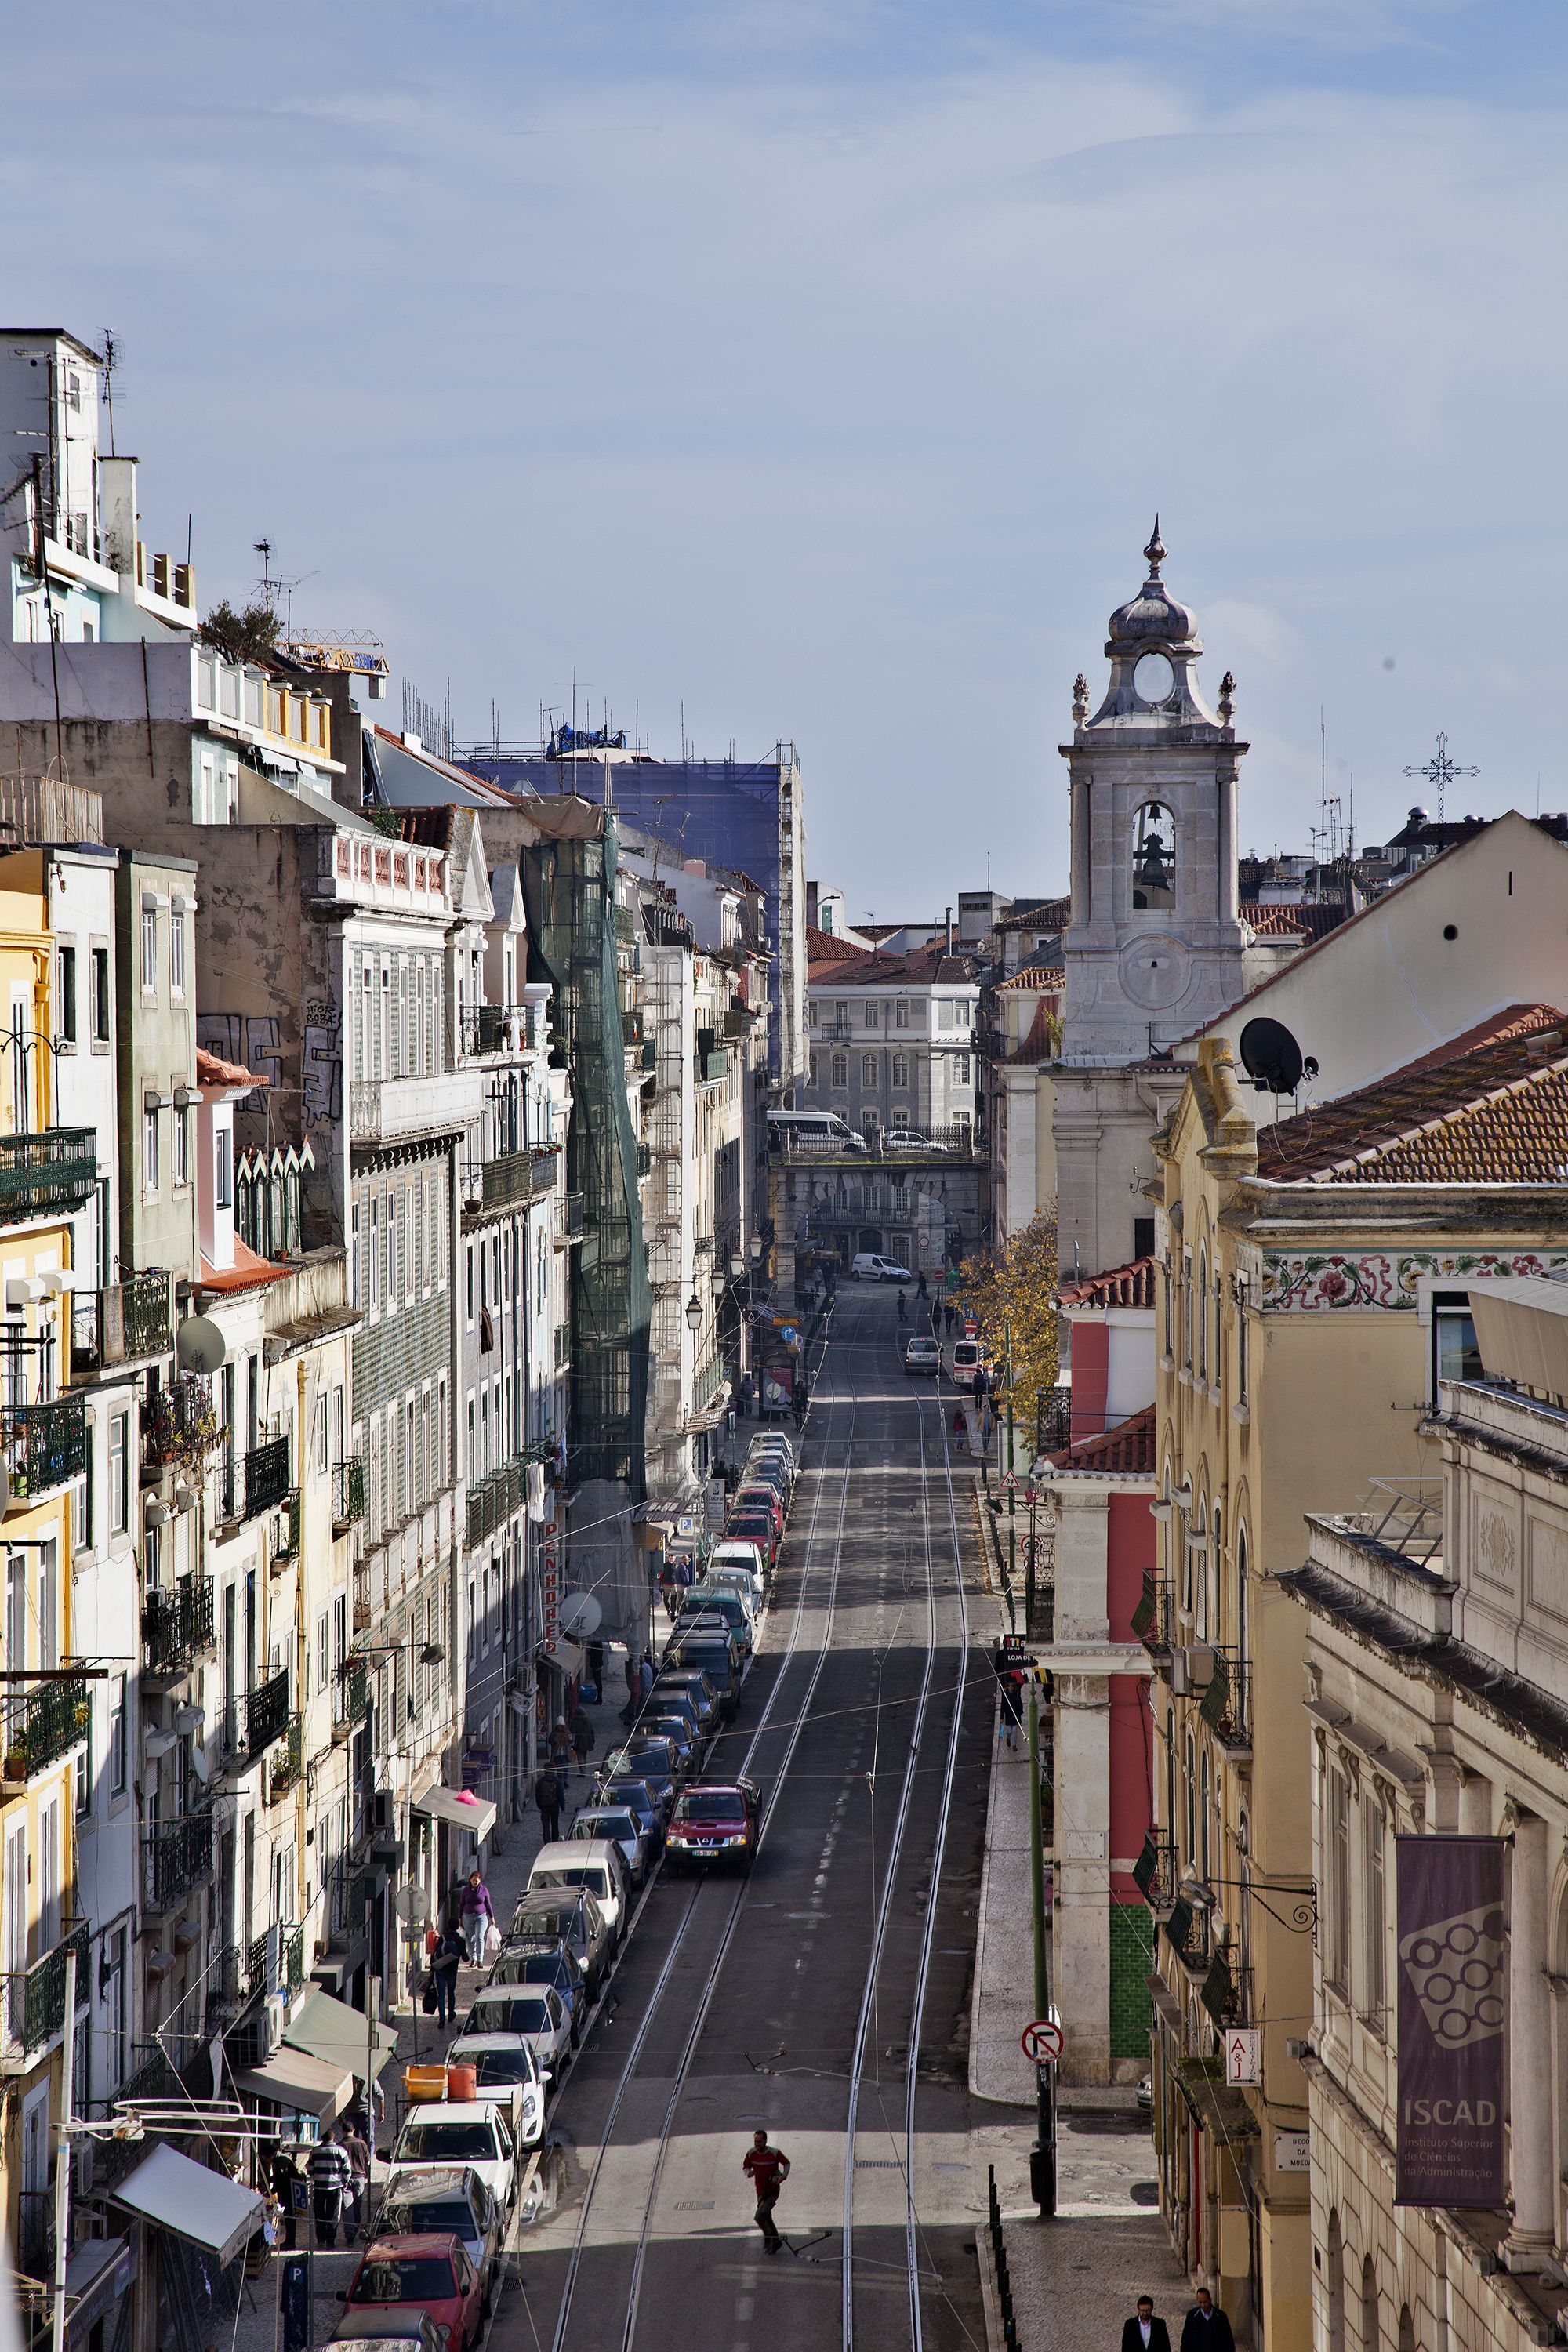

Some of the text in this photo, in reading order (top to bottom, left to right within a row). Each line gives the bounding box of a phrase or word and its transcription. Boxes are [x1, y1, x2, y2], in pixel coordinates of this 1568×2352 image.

[546, 1523, 557, 1656] PENHORES
[1231, 2038, 1246, 2053] A
[1234, 2063, 1241, 2078] J
[1405, 2100, 1496, 2125] ISCAD
[1405, 2137, 1494, 2150] Instituto Superior
[1404, 2151, 1461, 2162] de Ciências
[1404, 2166, 1493, 2180] da Administração
[294, 2185, 301, 2205] P
[293, 2268, 302, 2281] P
